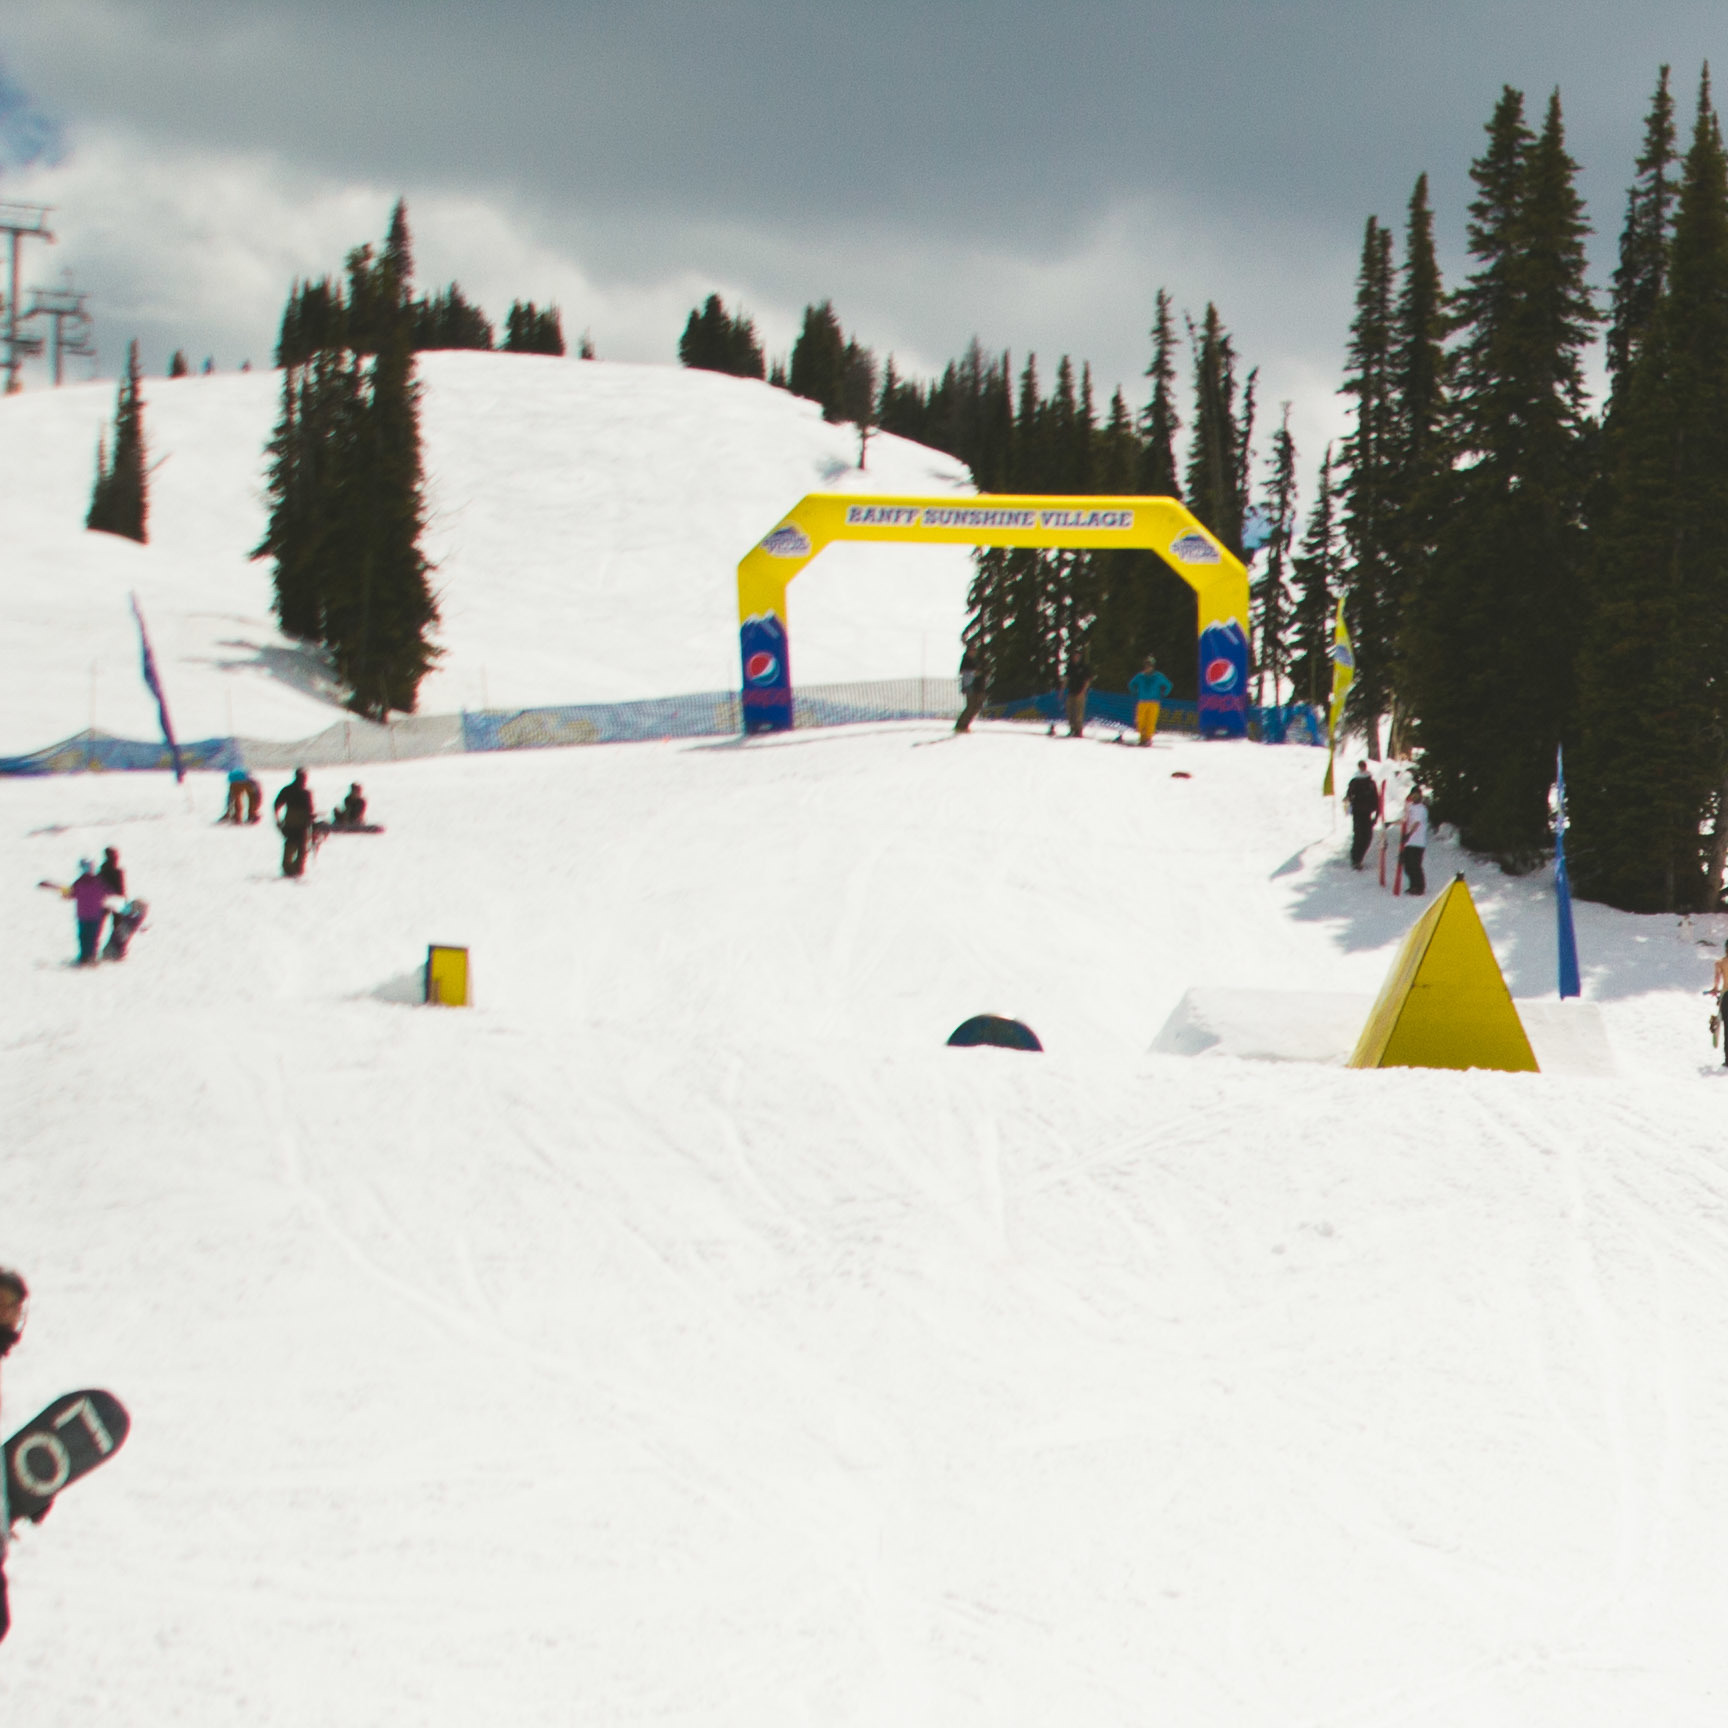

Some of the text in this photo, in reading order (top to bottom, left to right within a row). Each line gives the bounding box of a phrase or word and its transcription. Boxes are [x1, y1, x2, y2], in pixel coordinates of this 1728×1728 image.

[848, 506, 1133, 528] BANFF SUNSHINE VILLAGE
